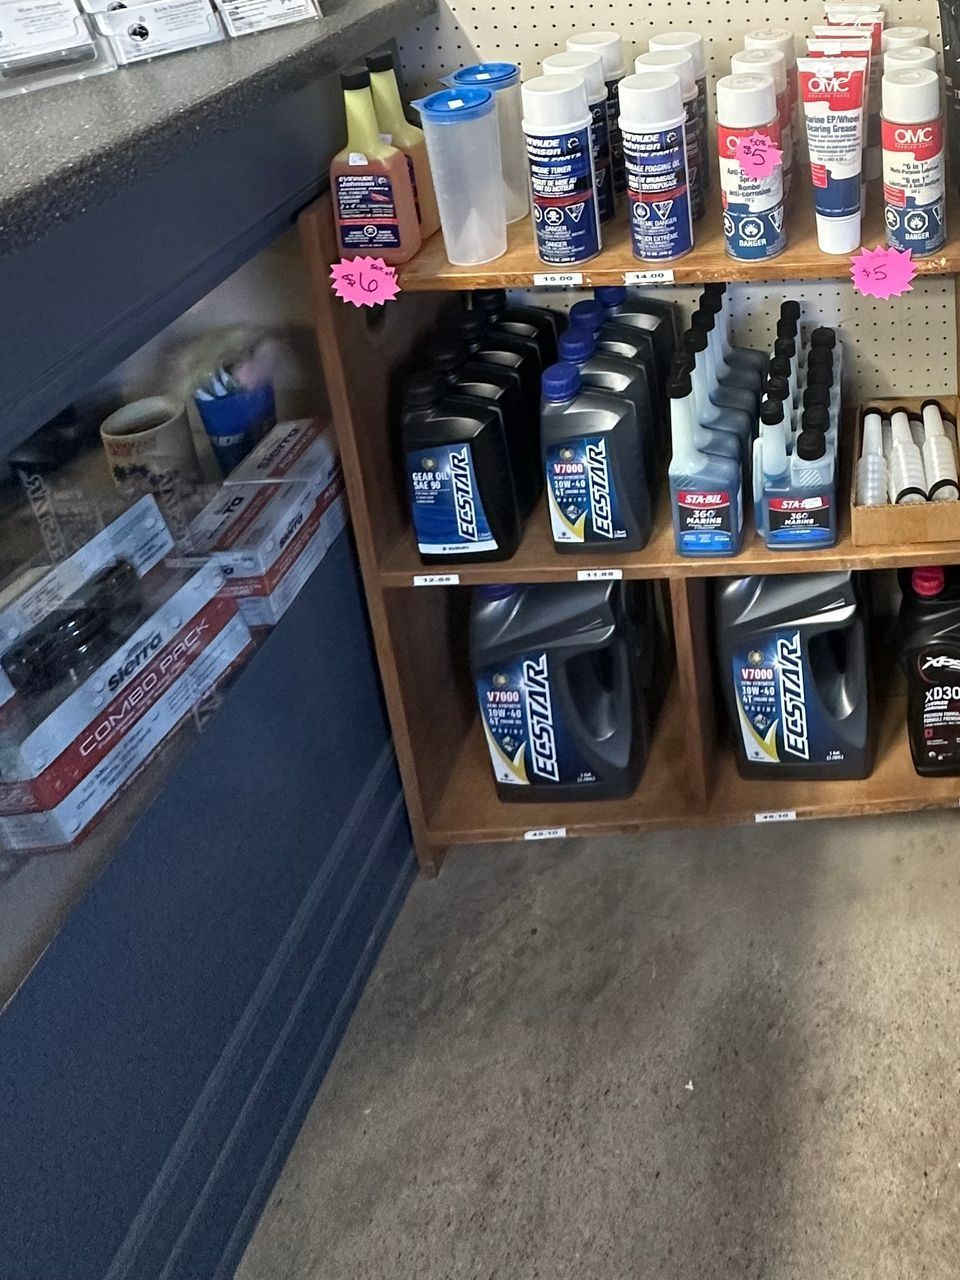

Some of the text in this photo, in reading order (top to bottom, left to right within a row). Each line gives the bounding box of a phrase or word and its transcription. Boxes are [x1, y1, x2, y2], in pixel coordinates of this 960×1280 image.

[807, 75, 850, 94] OMC
[832, 123, 858, 133] Grease
[894, 127, 933, 144] OMC
[743, 146, 767, 166] $5
[738, 184, 760, 192] Bombe
[905, 232, 930, 240] DANGER
[739, 237, 767, 248] DANGER
[633, 272, 665, 280] 14.00
[861, 264, 889, 281] $5
[341, 271, 379, 293] $6
[542, 275, 573, 283] 15.00
[553, 463, 584, 474] V7000
[412, 470, 450, 482] GEAR OIL
[413, 480, 442, 490] SAE 90
[554, 479, 586, 489] 10W-40
[586, 437, 613, 539] ECSTAR
[448, 446, 478, 541] ECSTAR
[554, 488, 566, 498] 4T
[692, 509, 715, 518] 360
[686, 515, 722, 525] MARINE
[784, 517, 815, 526] MARINE
[107, 631, 163, 692] sierra
[741, 668, 774, 680] V7000
[79, 617, 209, 756] COMBO PACK
[741, 686, 775, 696] 10W-40
[486, 690, 519, 703] V7000
[776, 630, 810, 760] ECSTAR
[488, 708, 522, 718] 10W-40
[523, 653, 560, 782] ECSTAR
